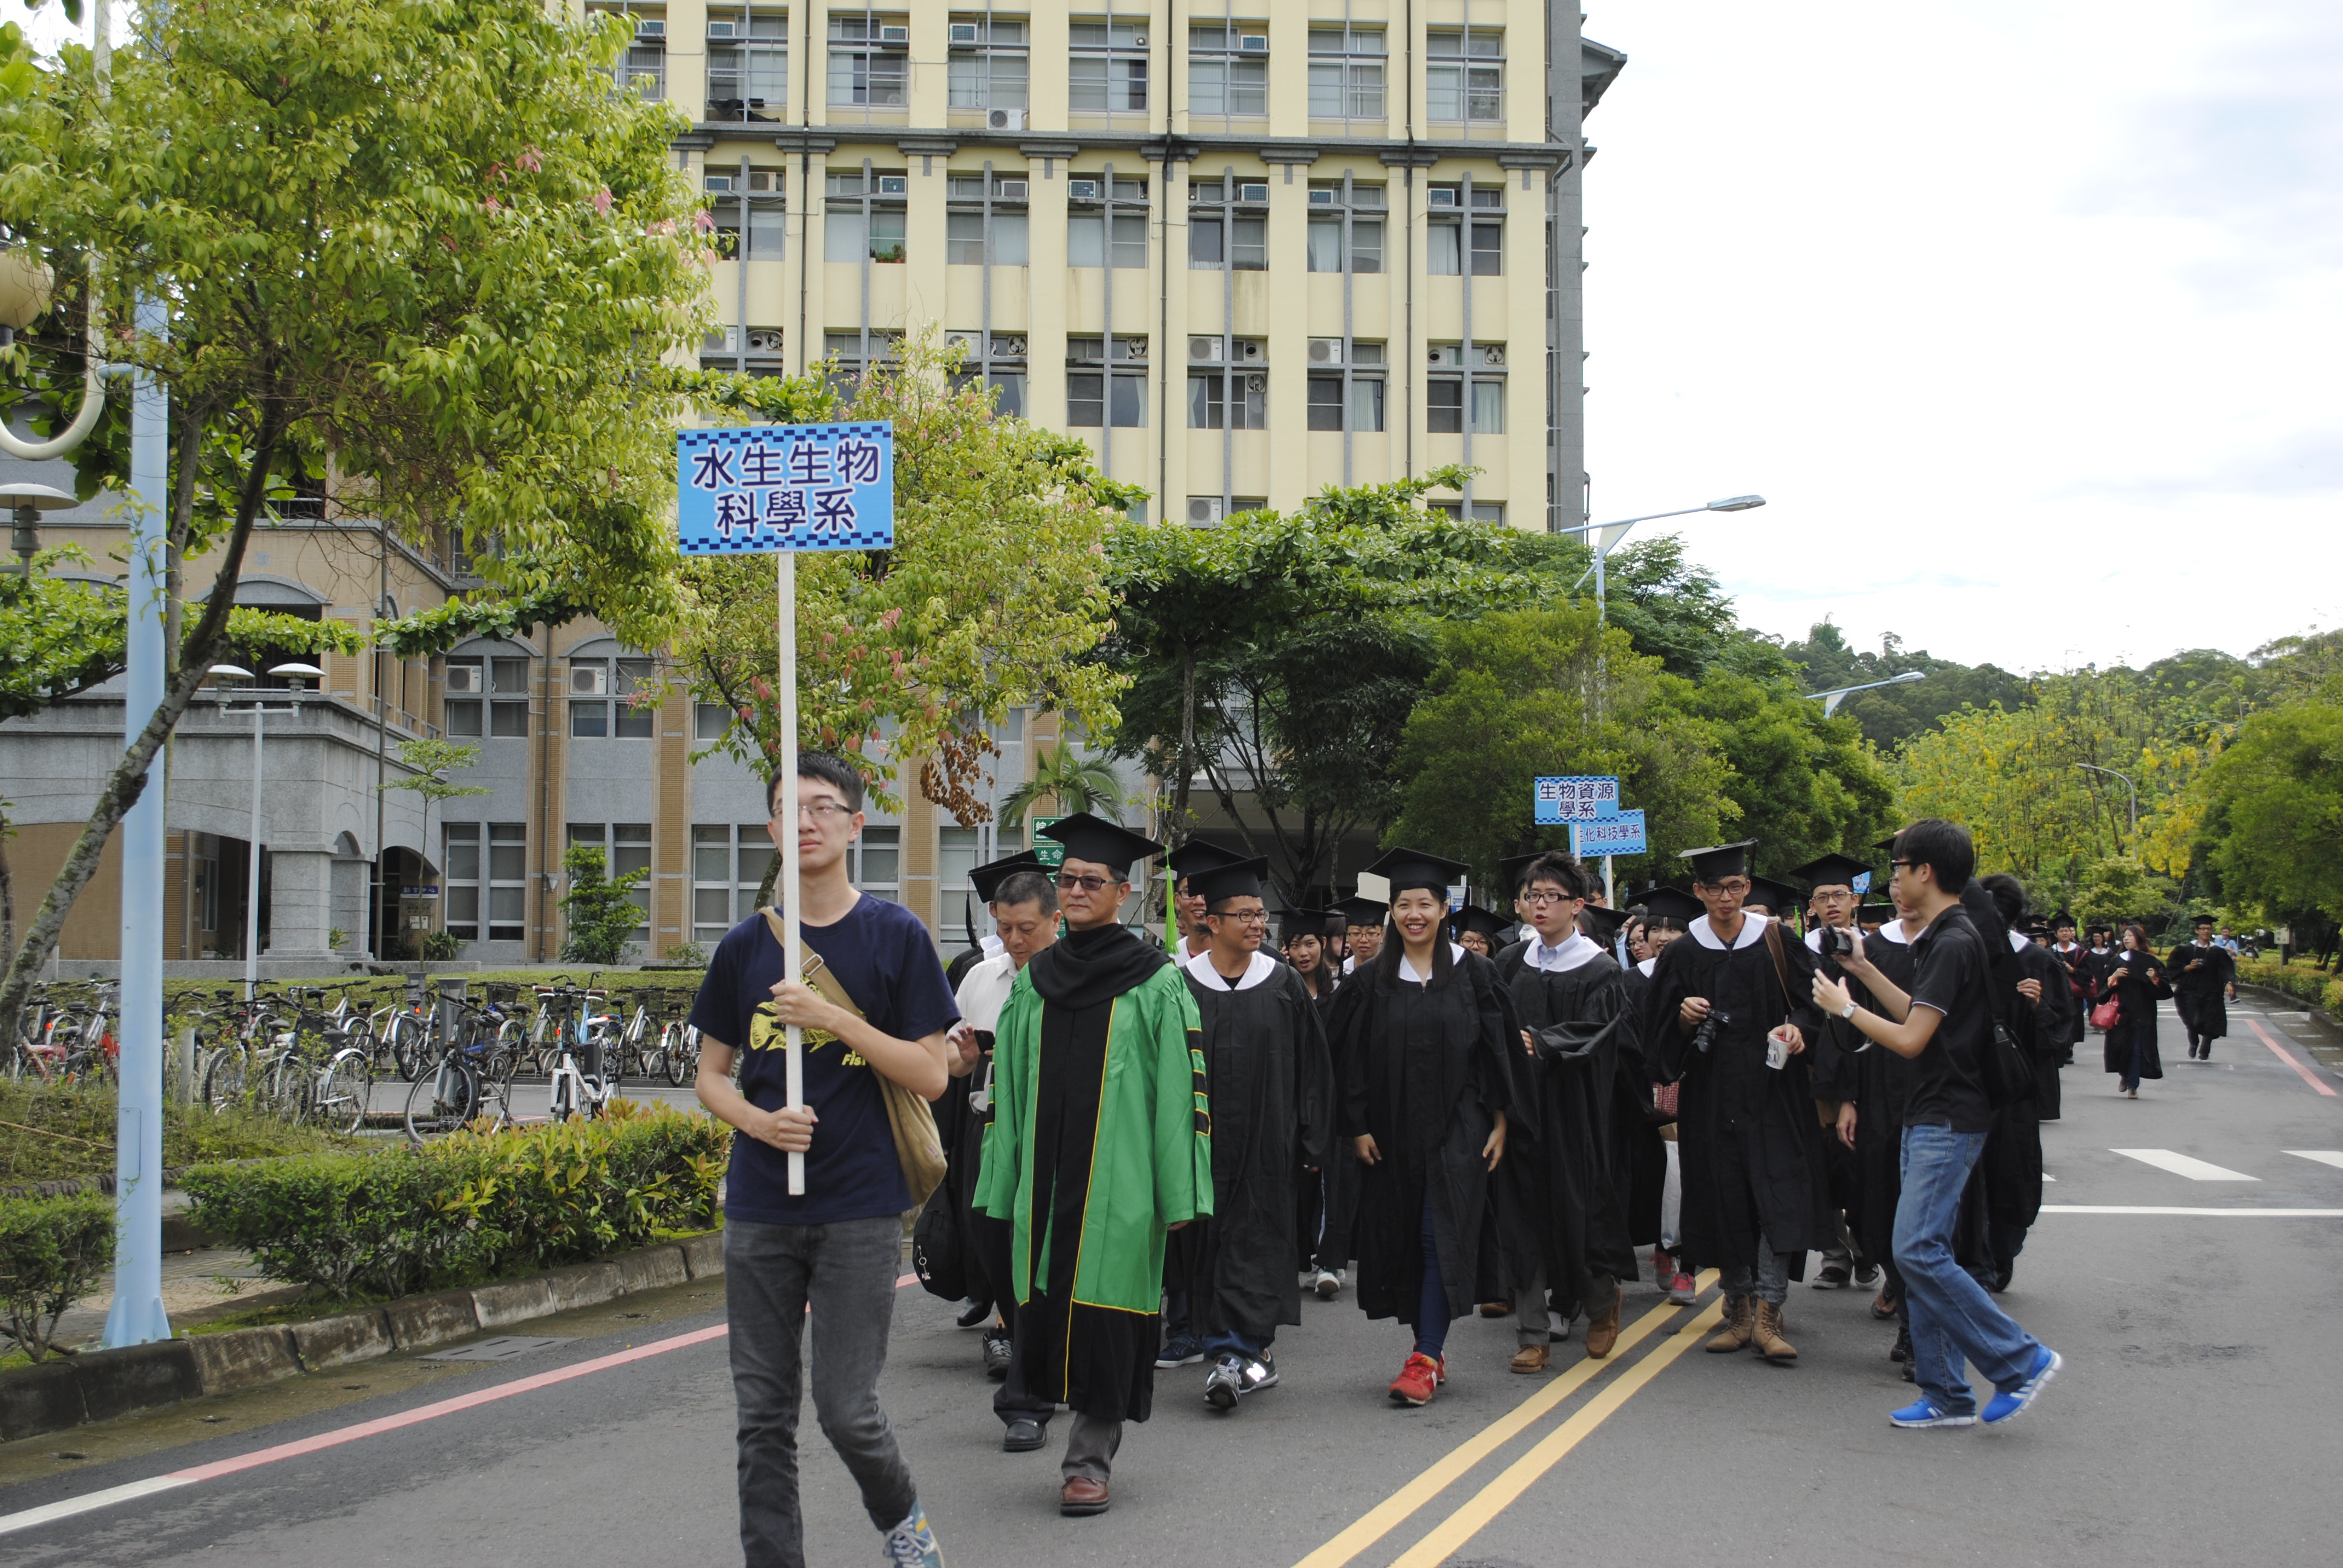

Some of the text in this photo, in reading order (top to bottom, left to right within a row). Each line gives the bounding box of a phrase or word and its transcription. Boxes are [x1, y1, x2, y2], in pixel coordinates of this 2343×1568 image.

[693, 440, 879, 489] 水生生物
[716, 488, 855, 536] 科學系
[1539, 782, 1614, 800] 生物資源
[1559, 800, 1595, 818] 學系
